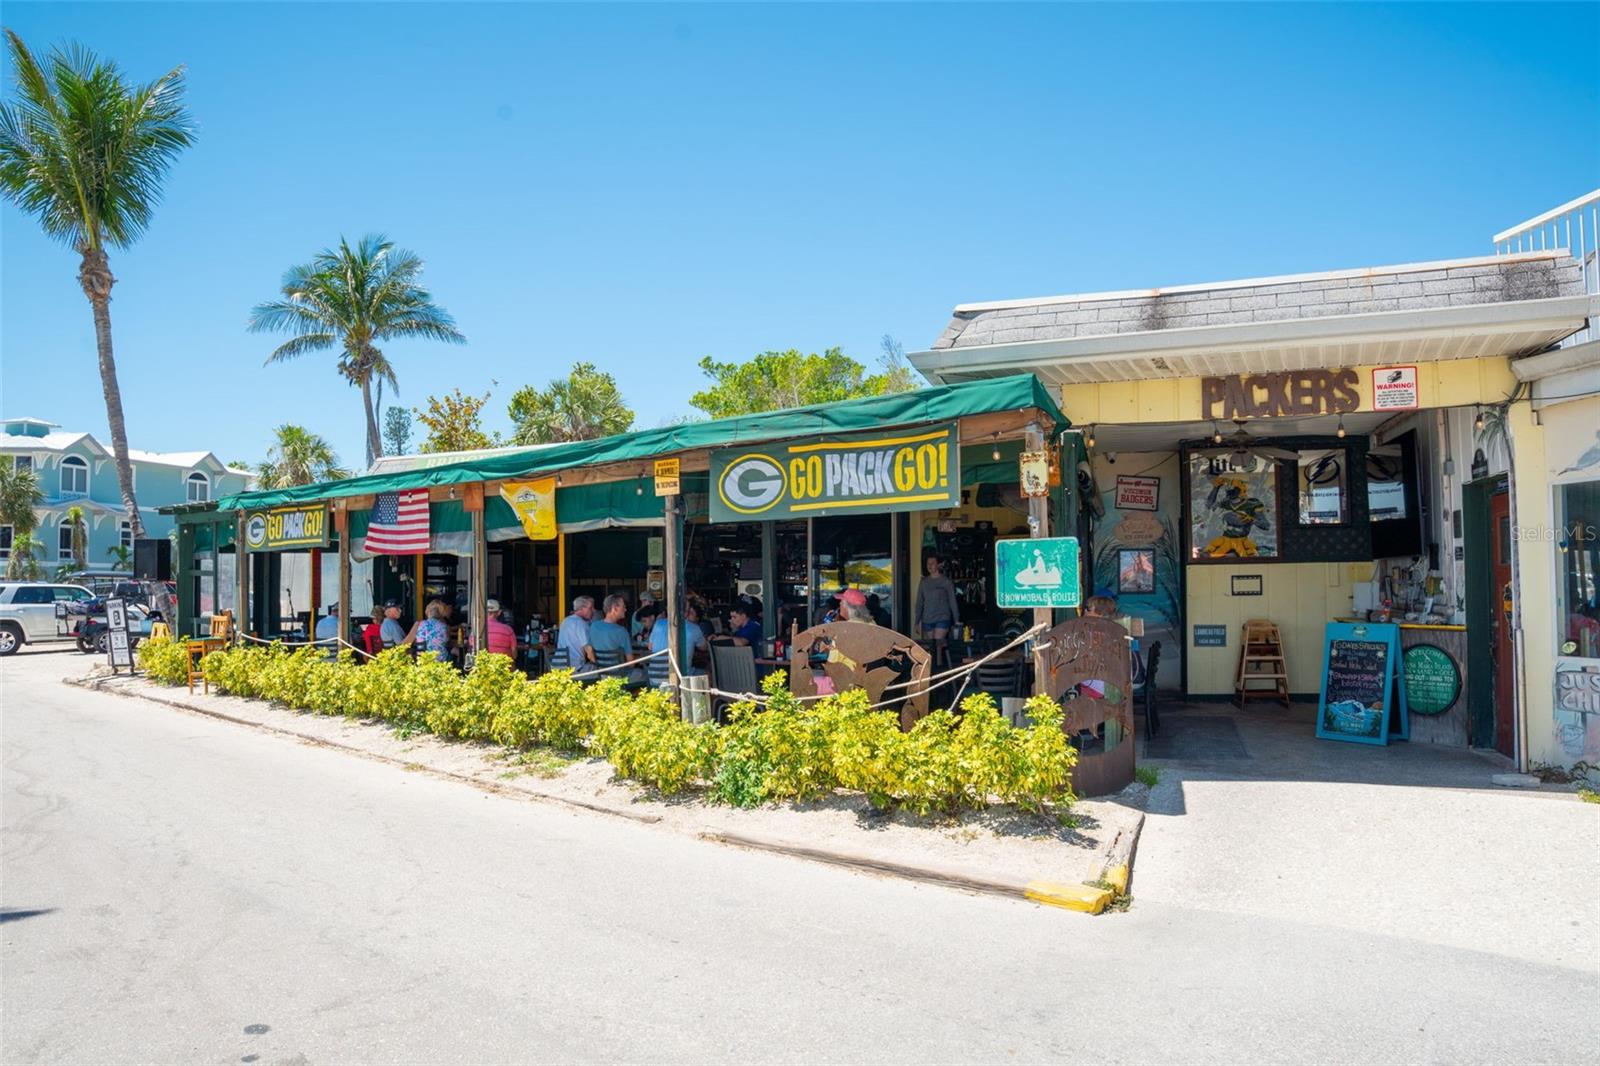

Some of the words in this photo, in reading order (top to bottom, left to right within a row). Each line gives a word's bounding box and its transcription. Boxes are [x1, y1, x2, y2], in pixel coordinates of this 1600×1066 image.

[1202, 369, 1360, 419] PACKERS
[789, 455, 822, 499] GO
[825, 450, 895, 496] PACK
[894, 443, 948, 491] GO!
[1120, 495, 1154, 505] BADGERS
[268, 515, 283, 540] GO
[283, 512, 305, 539] PACK
[304, 511, 323, 536] GO!
[1052, 591, 1077, 603] ROUTE
